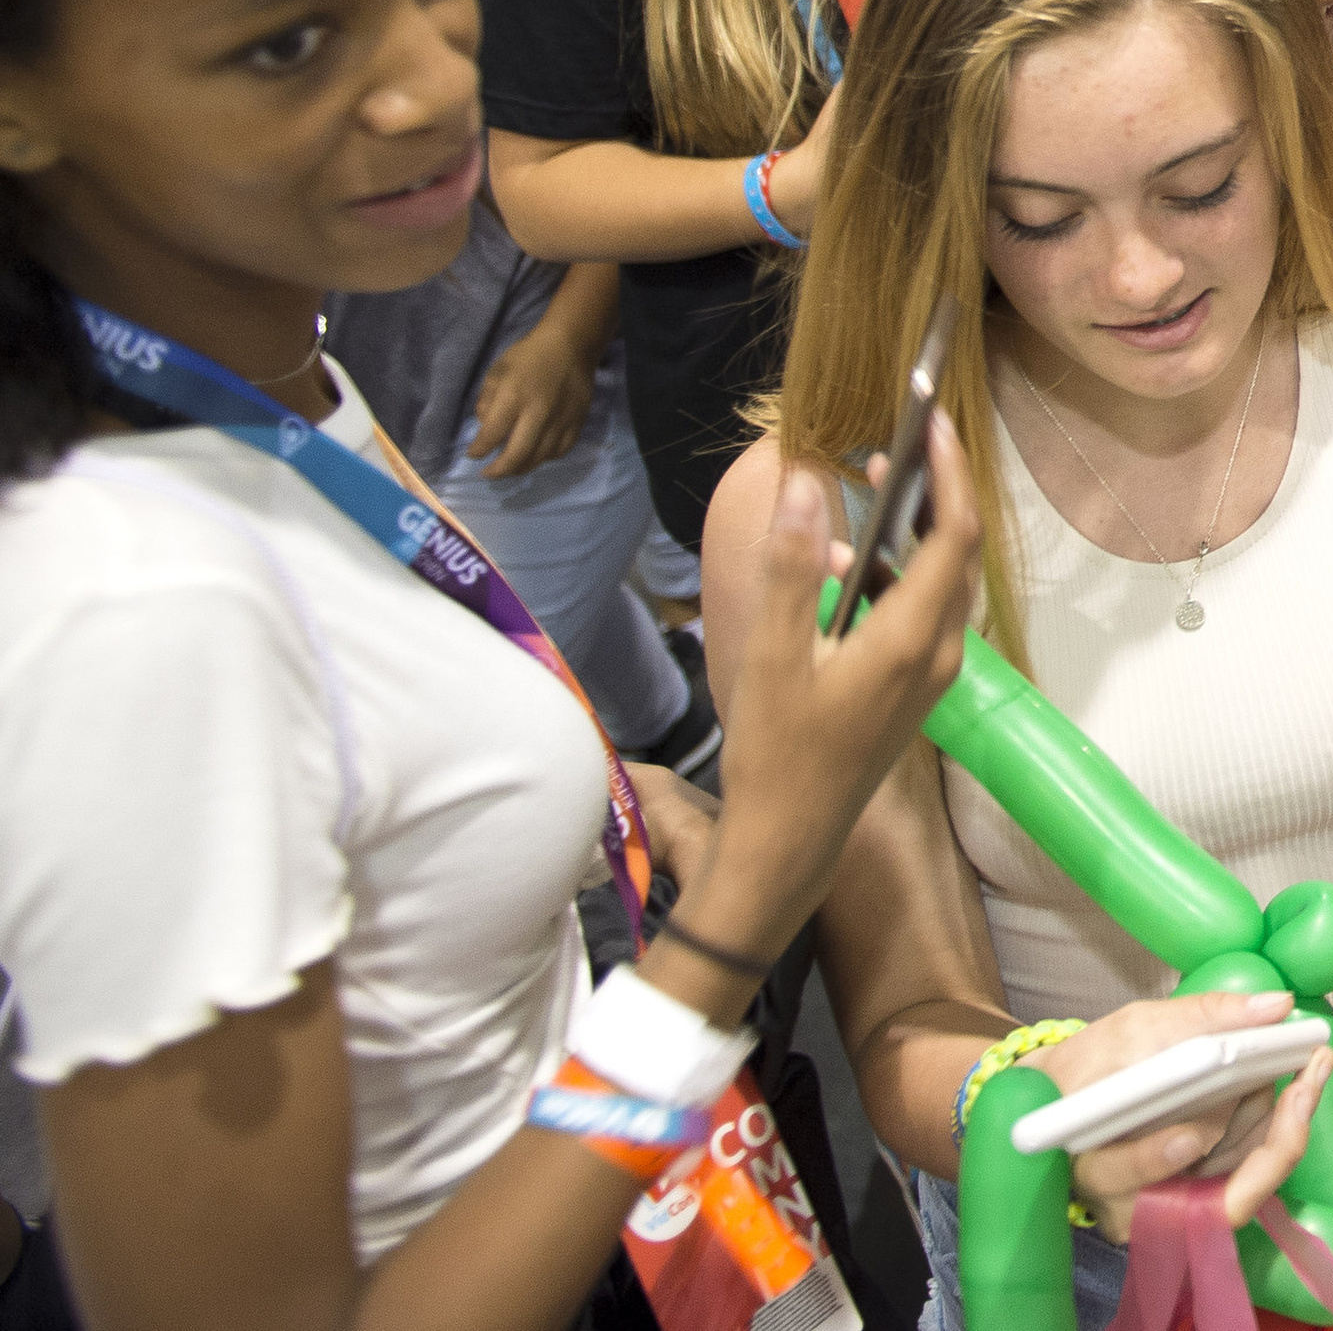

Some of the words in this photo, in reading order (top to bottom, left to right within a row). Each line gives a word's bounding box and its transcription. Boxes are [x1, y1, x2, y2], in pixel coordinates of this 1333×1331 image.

[83, 312, 169, 372] NIUS
[397, 504, 488, 585] GENIUS
[709, 1103, 776, 1169] CO
